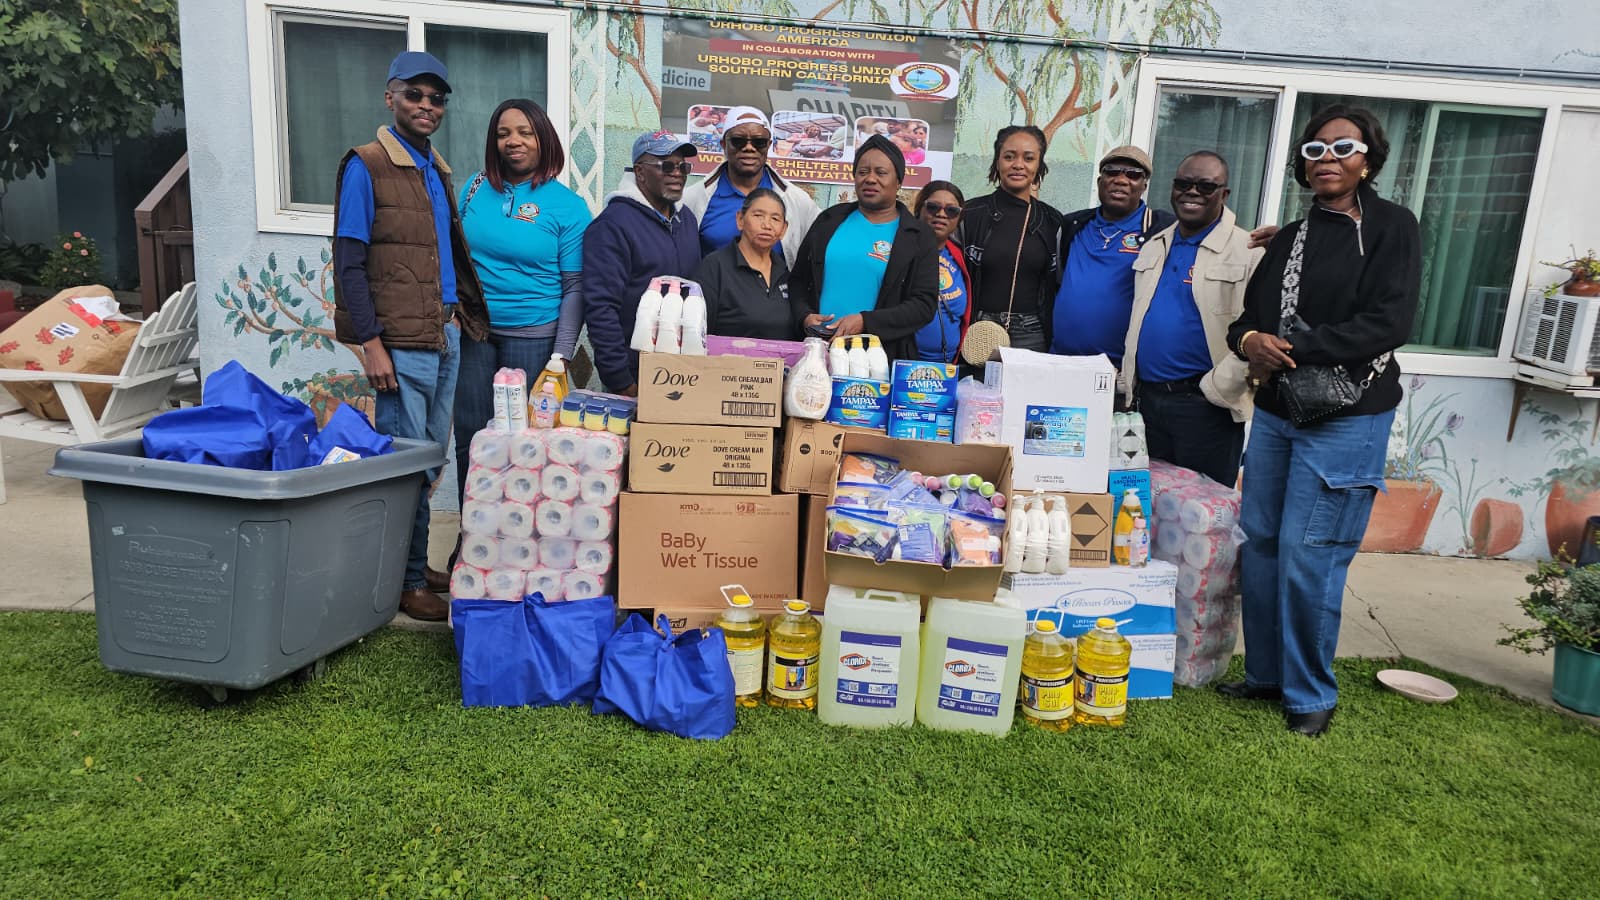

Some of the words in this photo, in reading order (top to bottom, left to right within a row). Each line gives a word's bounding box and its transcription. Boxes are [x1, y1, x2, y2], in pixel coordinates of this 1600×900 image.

[709, 20, 775, 33] URHOBO
[778, 25, 861, 39] PROGRESS
[865, 31, 917, 43] UNION
[776, 34, 849, 47] AMERICA
[742, 44, 754, 52] IN
[755, 45, 845, 57] COLLABORATION
[847, 52, 875, 60] WITH
[697, 54, 763, 67] URHOBO
[766, 59, 848, 73] PROGRESS
[852, 65, 904, 77] UNION
[708, 64, 792, 78] SOUTHERN
[795, 70, 892, 85] CALIFORNIA
[776, 159, 839, 172] SHELTER
[782, 168, 855, 181] INITIATIV
[652, 366, 699, 387] Dove
[905, 380, 944, 389] TAMPAX
[840, 397, 877, 406] TAMPAX
[643, 438, 691, 458] Dove
[660, 532, 707, 552] BaBy
[660, 552, 697, 568] Wet
[702, 552, 758, 569] Tissue
[843, 656, 867, 667] CLOROX
[947, 664, 972, 674] CLOROX
